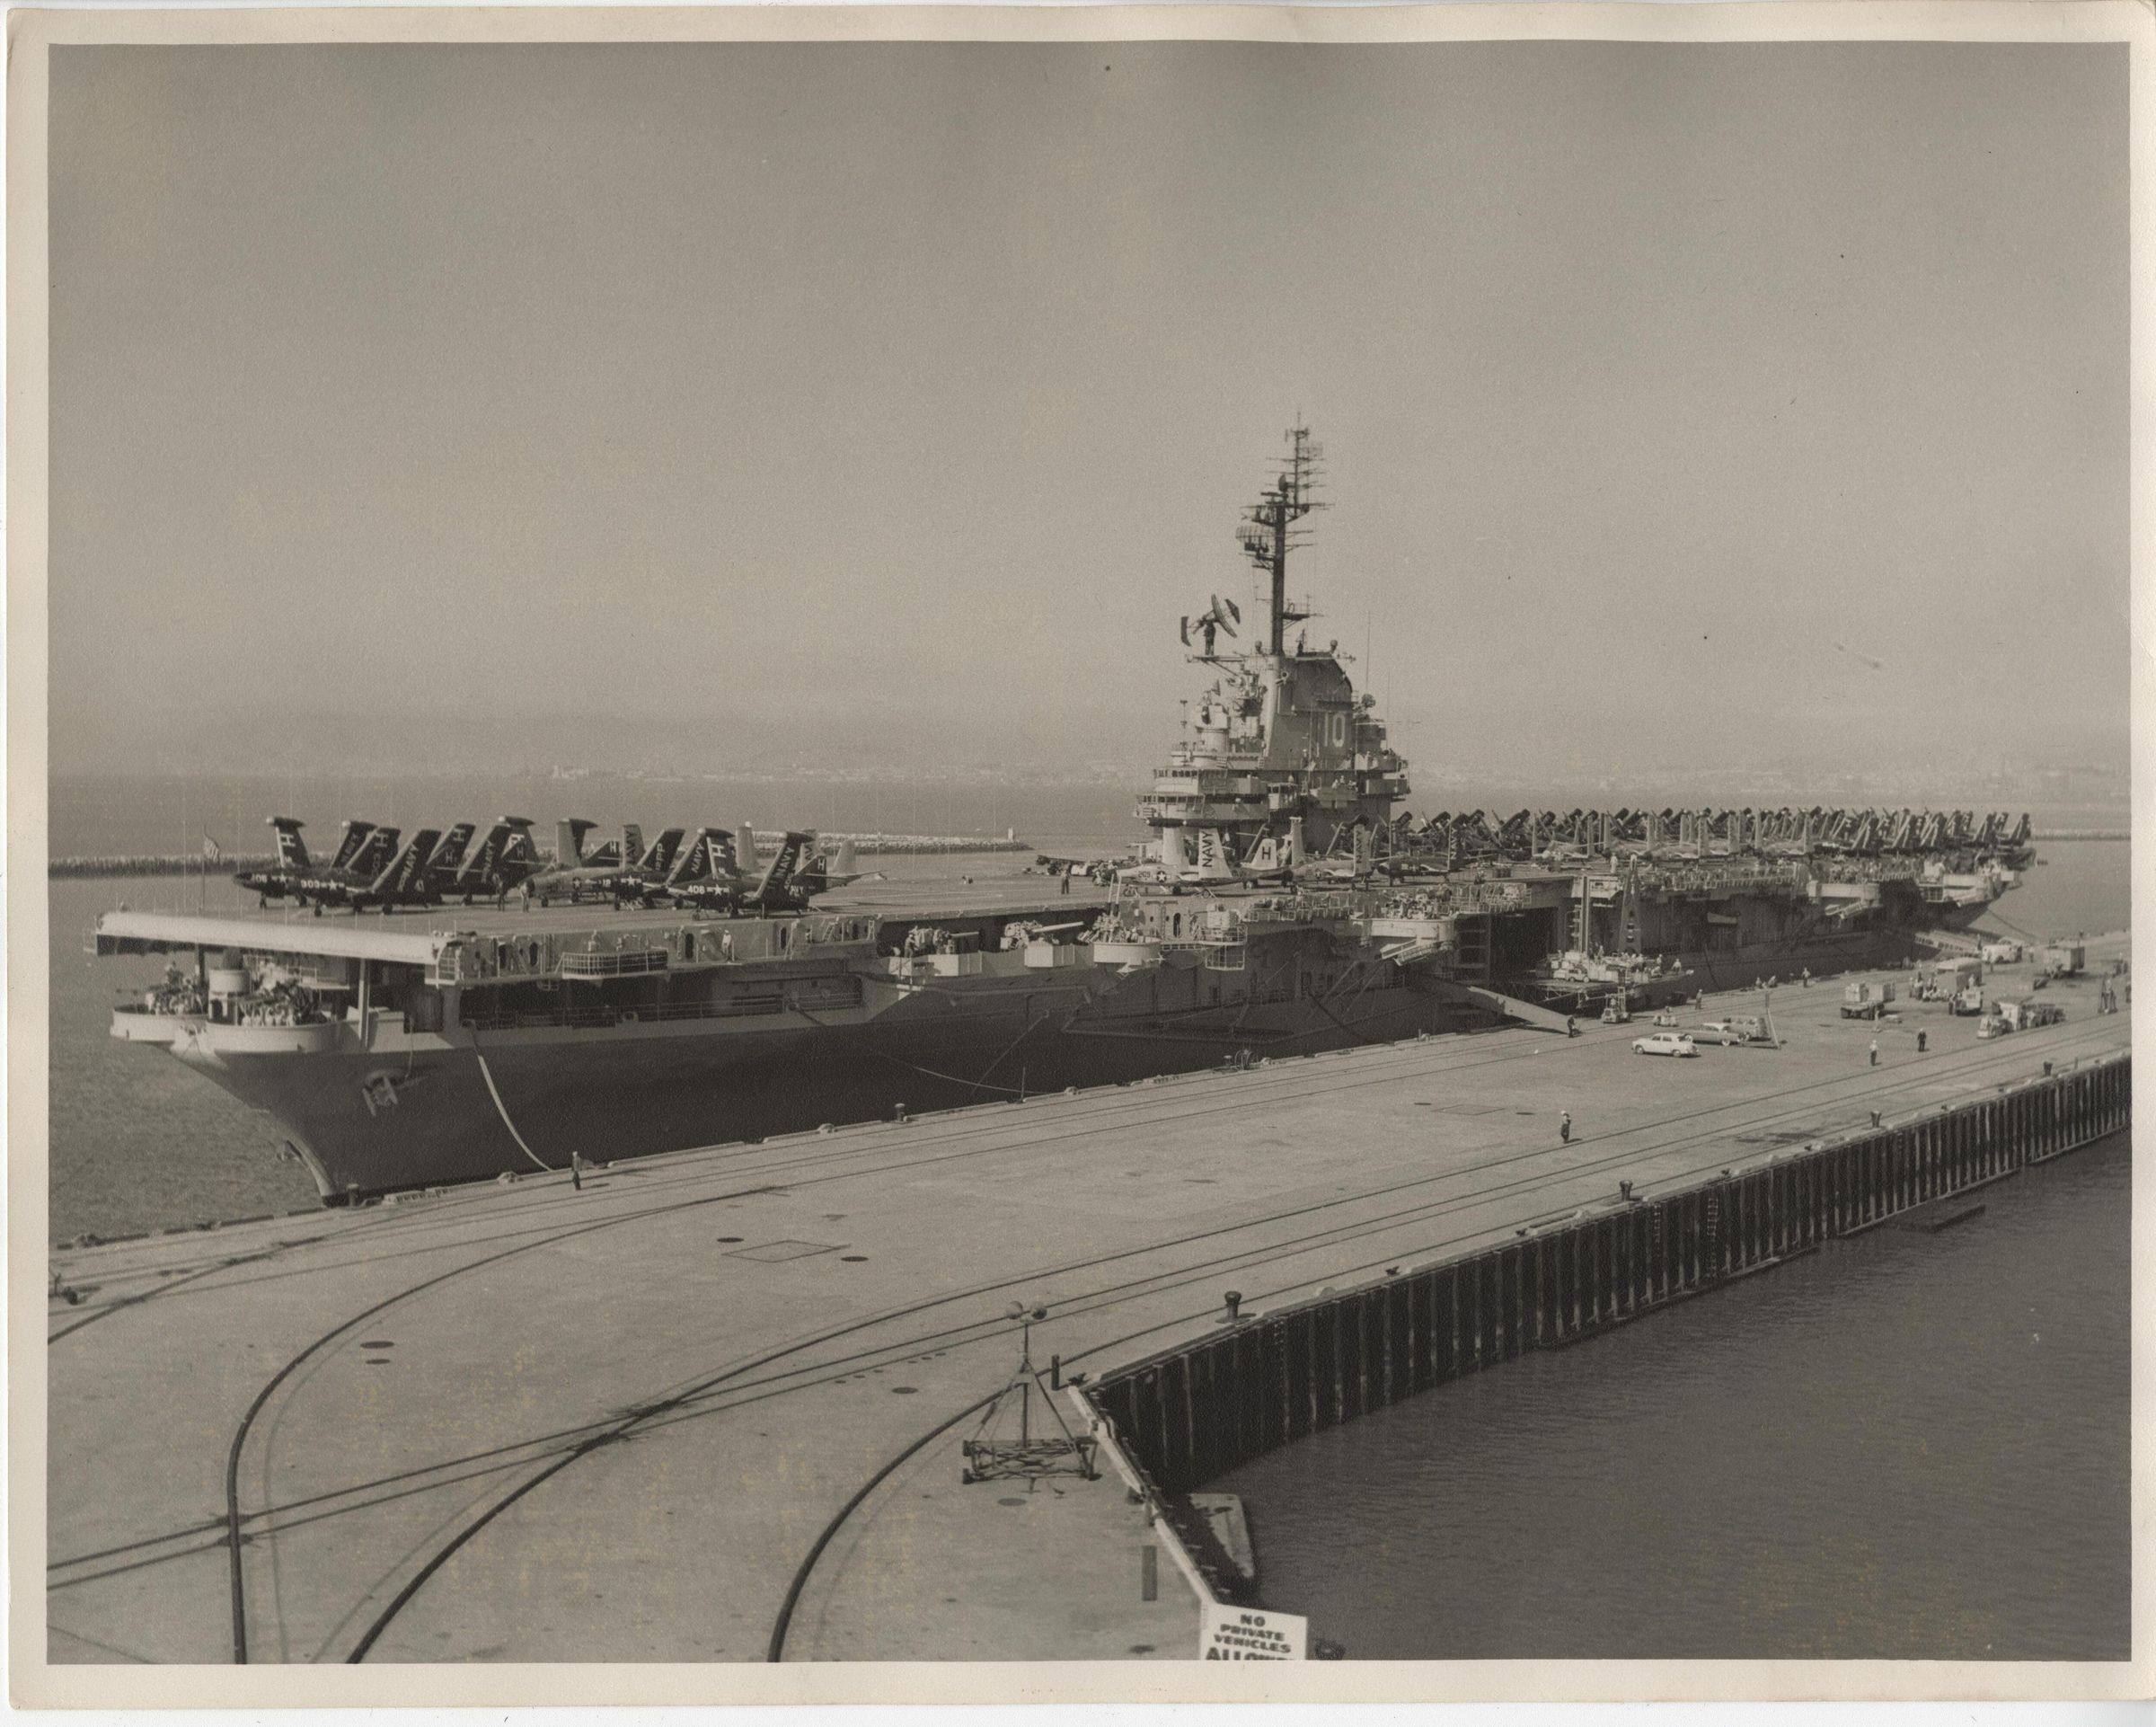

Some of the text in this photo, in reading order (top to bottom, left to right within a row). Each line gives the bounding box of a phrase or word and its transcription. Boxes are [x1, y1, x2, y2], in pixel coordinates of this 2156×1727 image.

[1324, 713, 1346, 748] 10
[278, 833, 296, 846] H
[375, 834, 389, 847] H
[452, 828, 466, 842] H
[609, 841, 617, 853] H
[711, 844, 727, 858] H
[1202, 831, 1213, 868] NAVY
[1261, 846, 1271, 860] H
[690, 843, 705, 873] NAVY
[776, 846, 795, 878] NAVY
[817, 858, 826, 871] H
[1241, 1615, 1266, 1627] NO
[1220, 1624, 1284, 1642] PRIVATE
[1214, 1634, 1291, 1653] VEHICLES
